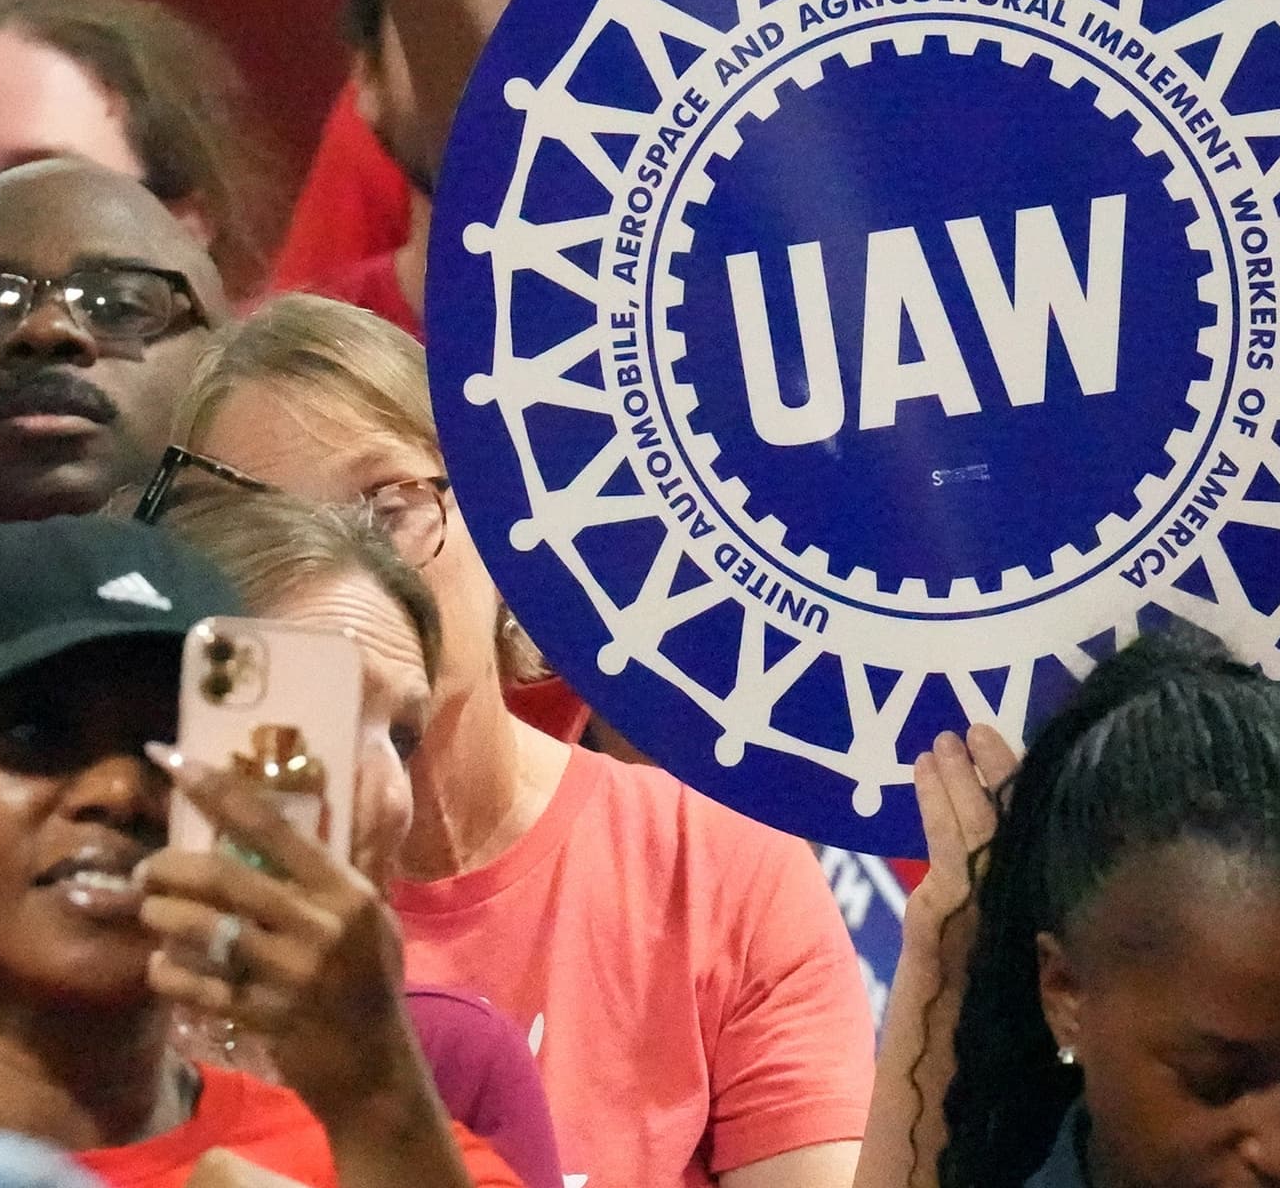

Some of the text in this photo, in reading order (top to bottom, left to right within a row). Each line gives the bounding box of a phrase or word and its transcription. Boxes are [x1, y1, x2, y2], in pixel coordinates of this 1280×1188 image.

[713, 21, 785, 87] AND
[1078, 11, 1242, 174] IMPLEMENT
[612, 87, 710, 285] AEROSPACE
[726, 194, 1127, 446] UAW
[1230, 187, 1277, 371] WORKERS
[610, 299, 717, 540] AUTOMOBILE,
[1231, 388, 1266, 439] OF
[713, 542, 830, 634] UNITED
[1119, 450, 1240, 589] AMERICA
